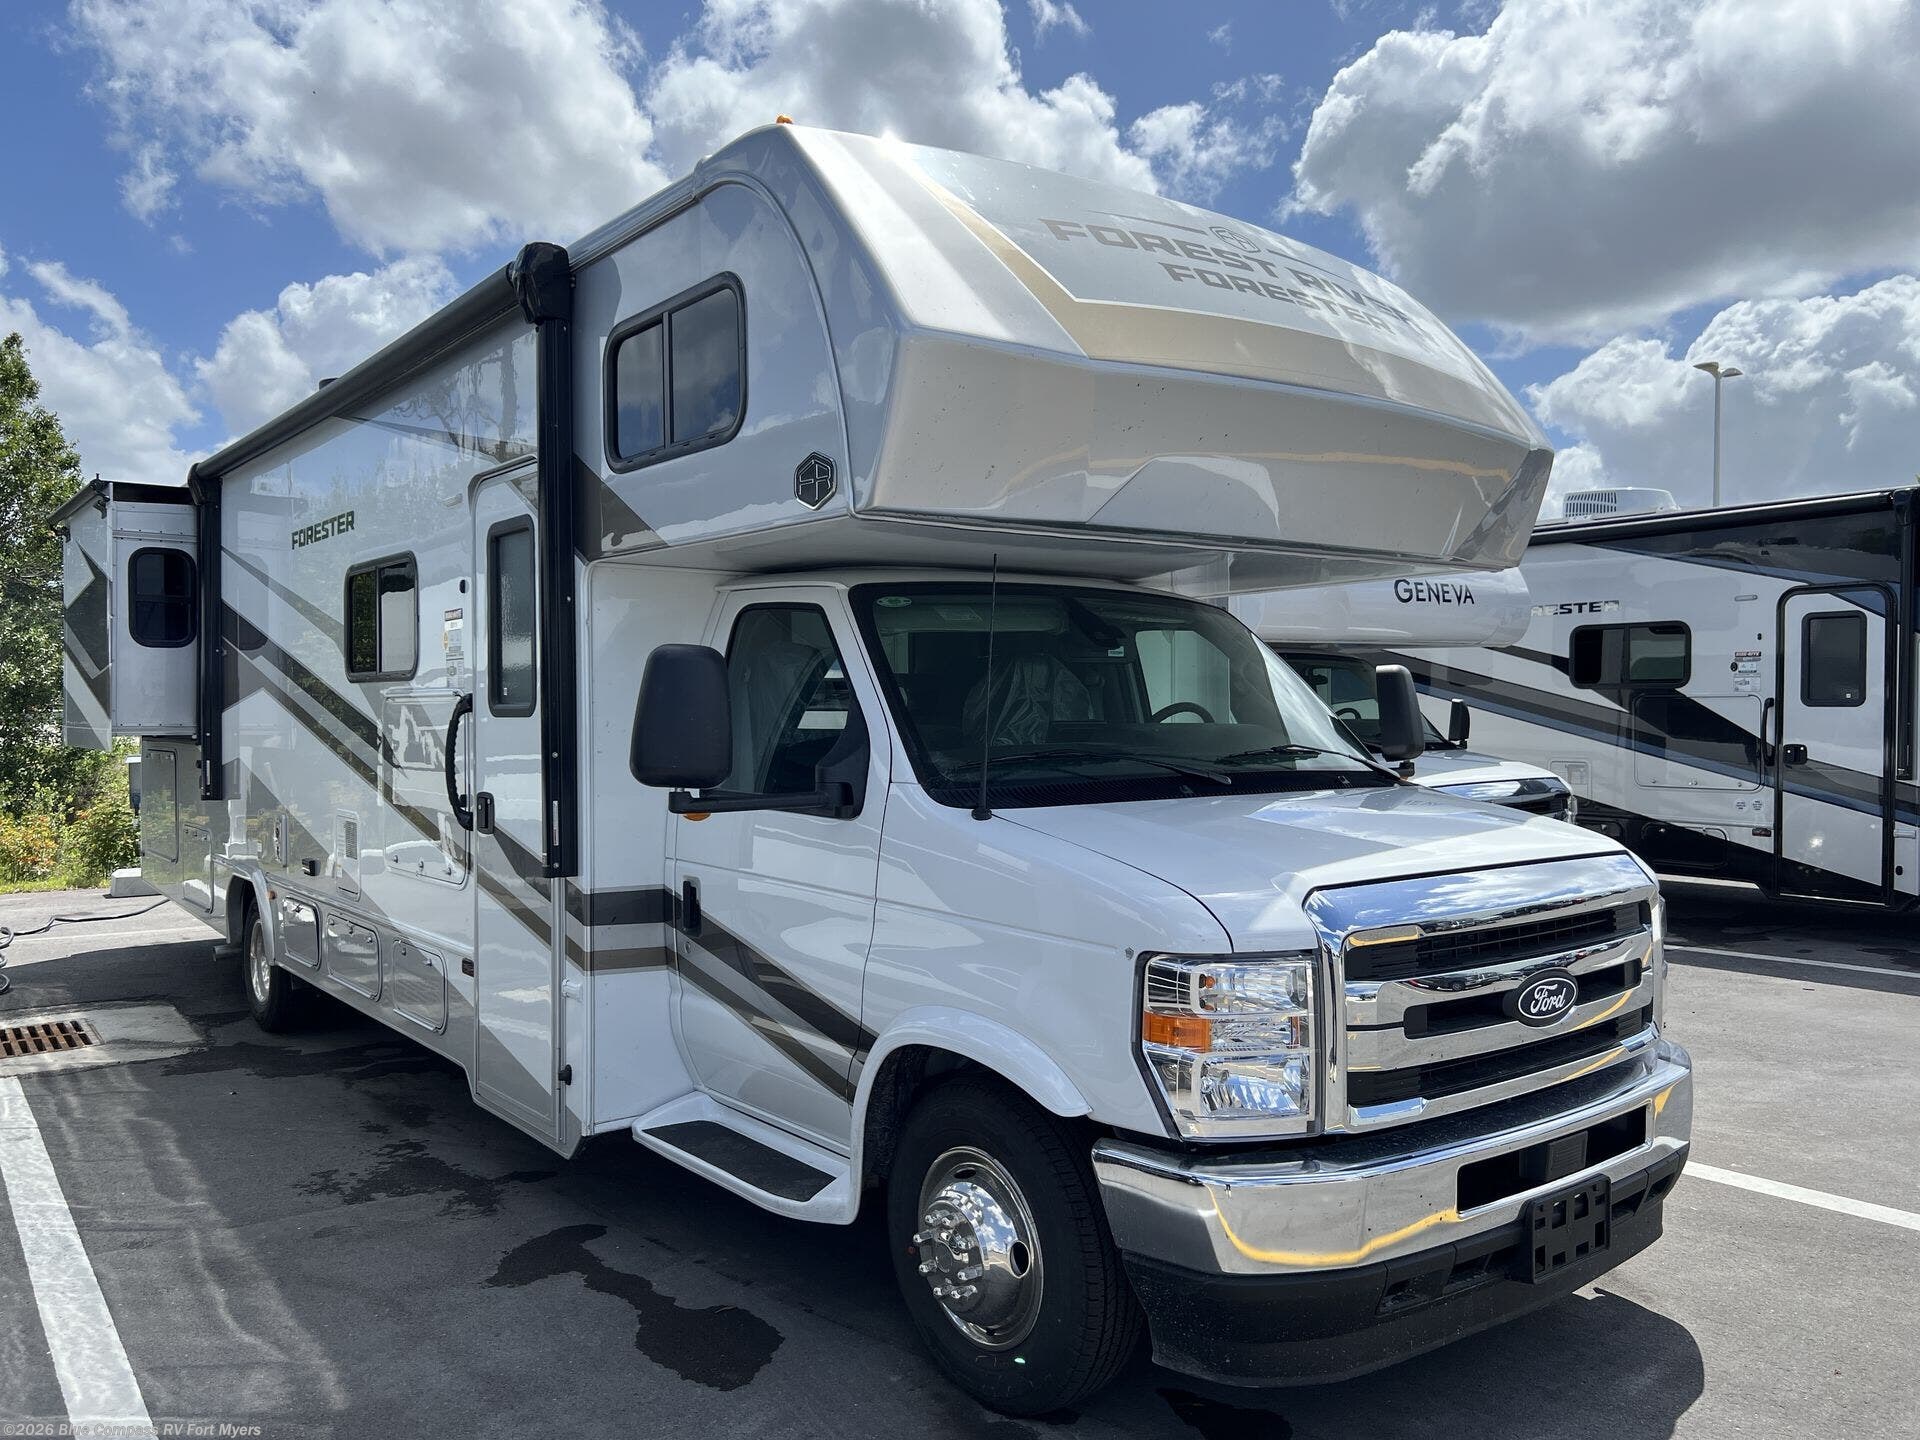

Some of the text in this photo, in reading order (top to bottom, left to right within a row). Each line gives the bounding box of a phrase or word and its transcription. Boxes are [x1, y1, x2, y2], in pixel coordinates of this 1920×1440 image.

[1038, 218, 1279, 279] FOREST
[1158, 261, 1396, 335] FORESTER
[291, 510, 355, 550] FORESTER
[1393, 578, 1475, 607] GENEVA
[1530, 600, 1620, 617] RESTER
[1530, 983, 1567, 1014] Ford
